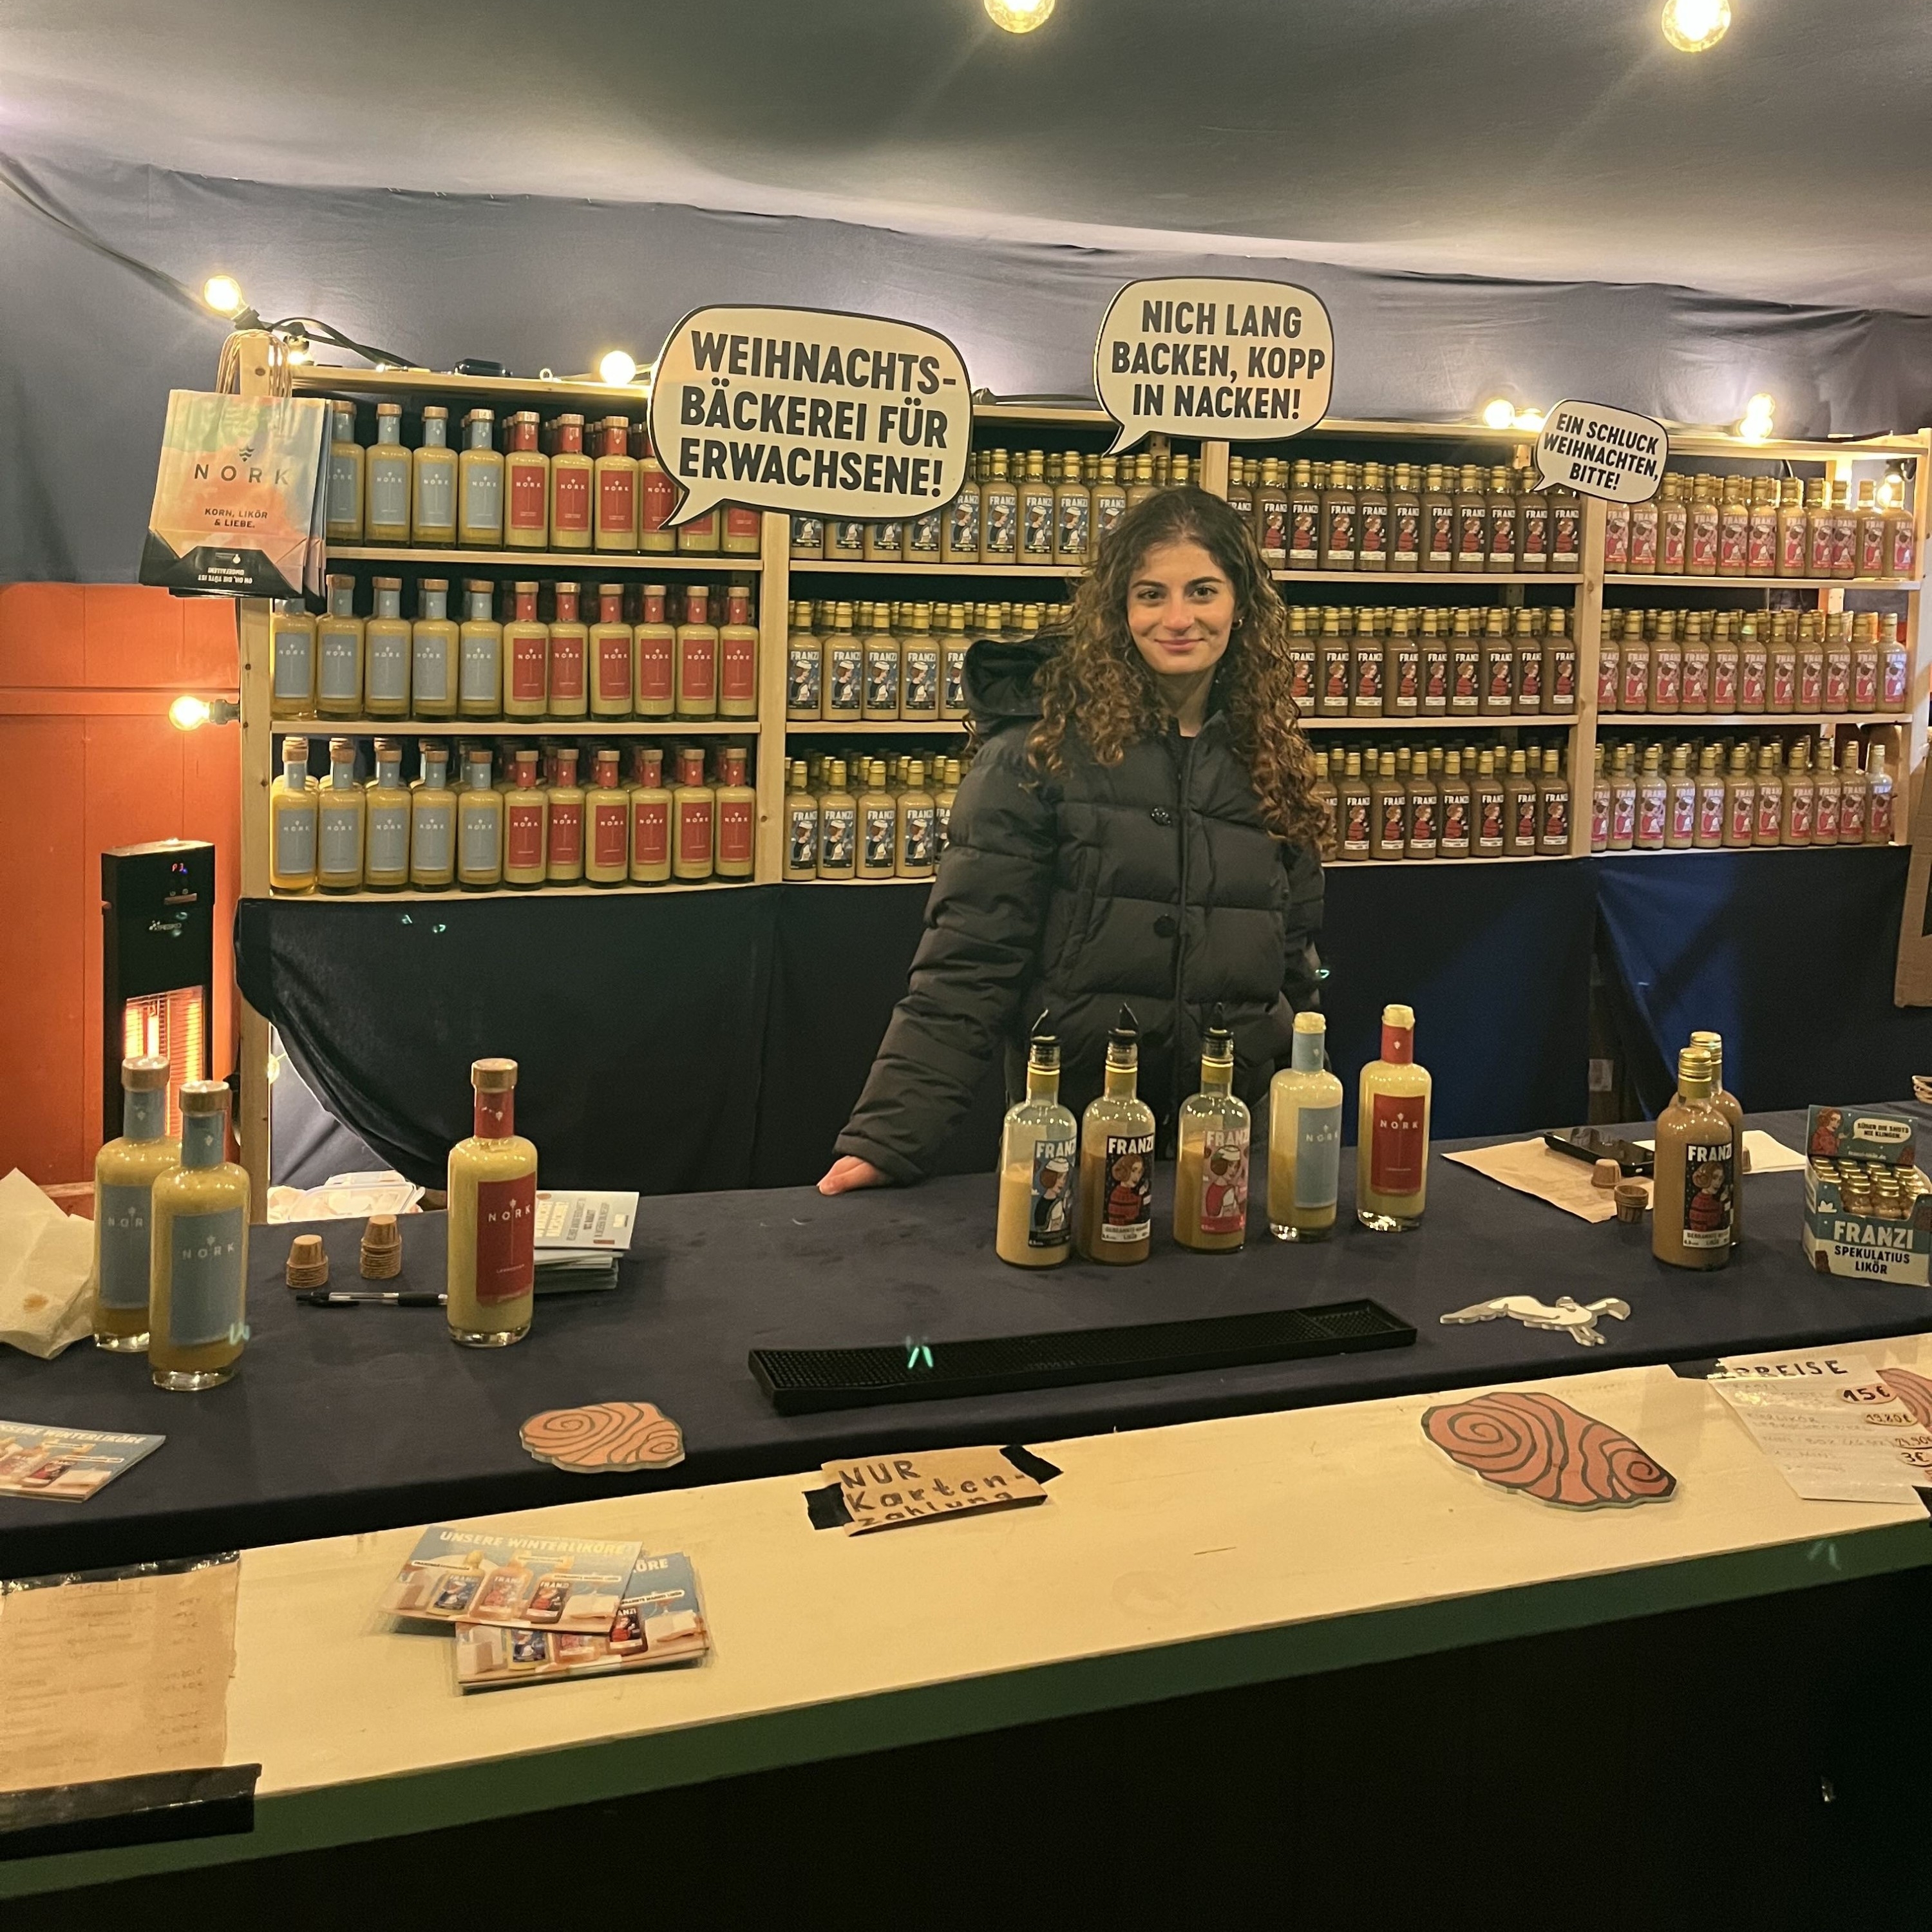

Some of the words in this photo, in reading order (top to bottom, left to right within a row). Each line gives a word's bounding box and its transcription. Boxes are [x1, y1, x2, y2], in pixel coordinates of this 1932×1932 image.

[1142, 299, 1216, 335] NICH
[1226, 303, 1302, 339] LANG
[690, 330, 956, 395] WEIHNACHTS-
[1112, 341, 1238, 384] BACKEN,
[1247, 346, 1326, 380] KOPP
[680, 377, 867, 440] BÄCKEREI
[878, 396, 948, 449] FÜR
[1133, 383, 1164, 416] IN
[1173, 384, 1301, 420] NACKEN!
[1556, 413, 1584, 435] EIN
[1586, 421, 1659, 455] SCHLUCK
[679, 437, 943, 498] ERWACHSENE!
[1544, 431, 1658, 482] WEIHNACHTEN,
[194, 463, 290, 485] NORK
[1569, 462, 1621, 491] BITTE!
[958, 495, 979, 504] RANZ
[205, 508, 235, 518] KORN,
[238, 509, 268, 518] LIKÖR
[225, 519, 255, 528] LIEBE.
[1380, 1119, 1418, 1130] NORK
[1306, 1132, 1339, 1143] NORK
[108, 1218, 143, 1228] NOR
[488, 1204, 531, 1222] NORK
[1833, 1220, 1913, 1249] FRANZI
[182, 1242, 236, 1260] NORK
[1834, 1245, 1910, 1264] SPEKULATIUS
[1855, 1260, 1888, 1274] LIKÖR
[1843, 1385, 1891, 1402] 15€
[838, 1460, 922, 1488] NUR
[440, 1531, 504, 1546] UNSERE
[507, 1537, 624, 1555] WINTERLIKÖRE
